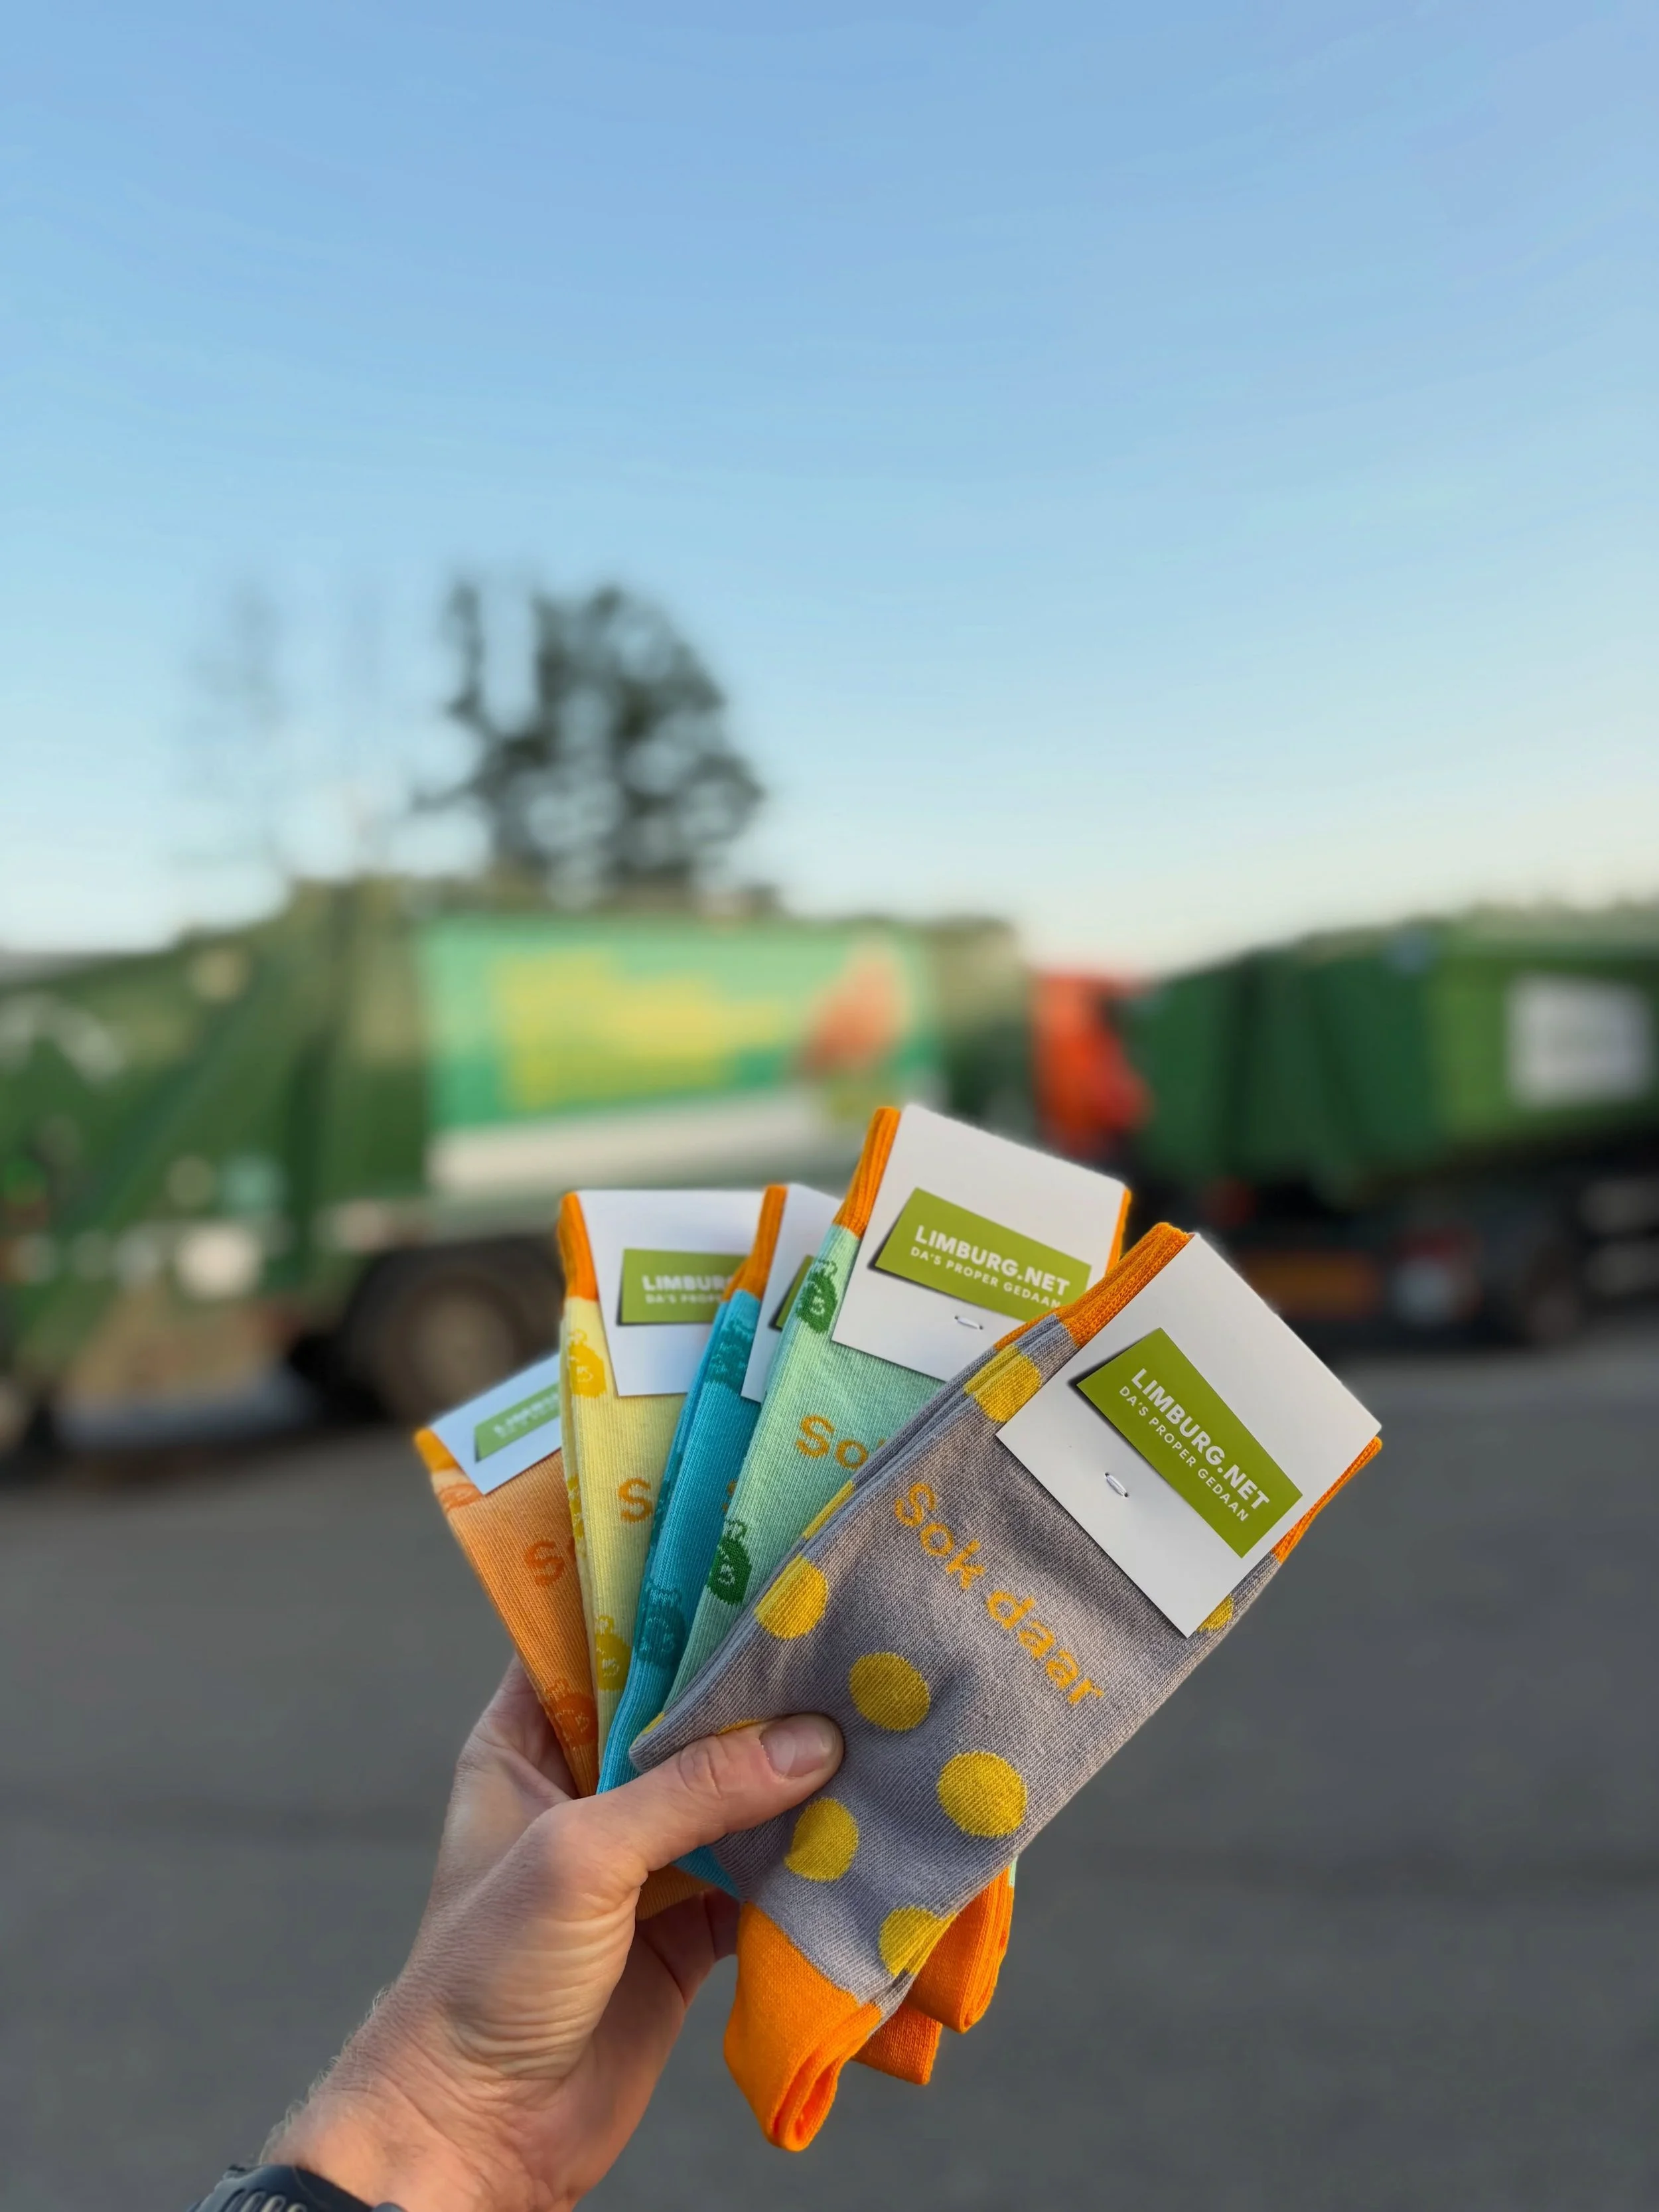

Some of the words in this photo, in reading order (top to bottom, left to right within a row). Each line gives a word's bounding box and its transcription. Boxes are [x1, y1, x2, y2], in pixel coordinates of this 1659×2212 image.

[910, 1246, 942, 1266] DA'S
[946, 1260, 998, 1287] PROPER
[1003, 1282, 1061, 1309] GEDAAN
[914, 1225, 1070, 1295] LIMBURG.NET
[796, 1414, 887, 1470] So
[1119, 1386, 1149, 1416] DA'S
[1149, 1417, 1196, 1467] PROPER
[1197, 1468, 1250, 1521] GEDAAN
[1131, 1368, 1270, 1510] LIMBURG.NET
[895, 1482, 985, 1590] Sok
[985, 1589, 1104, 1706] daar
